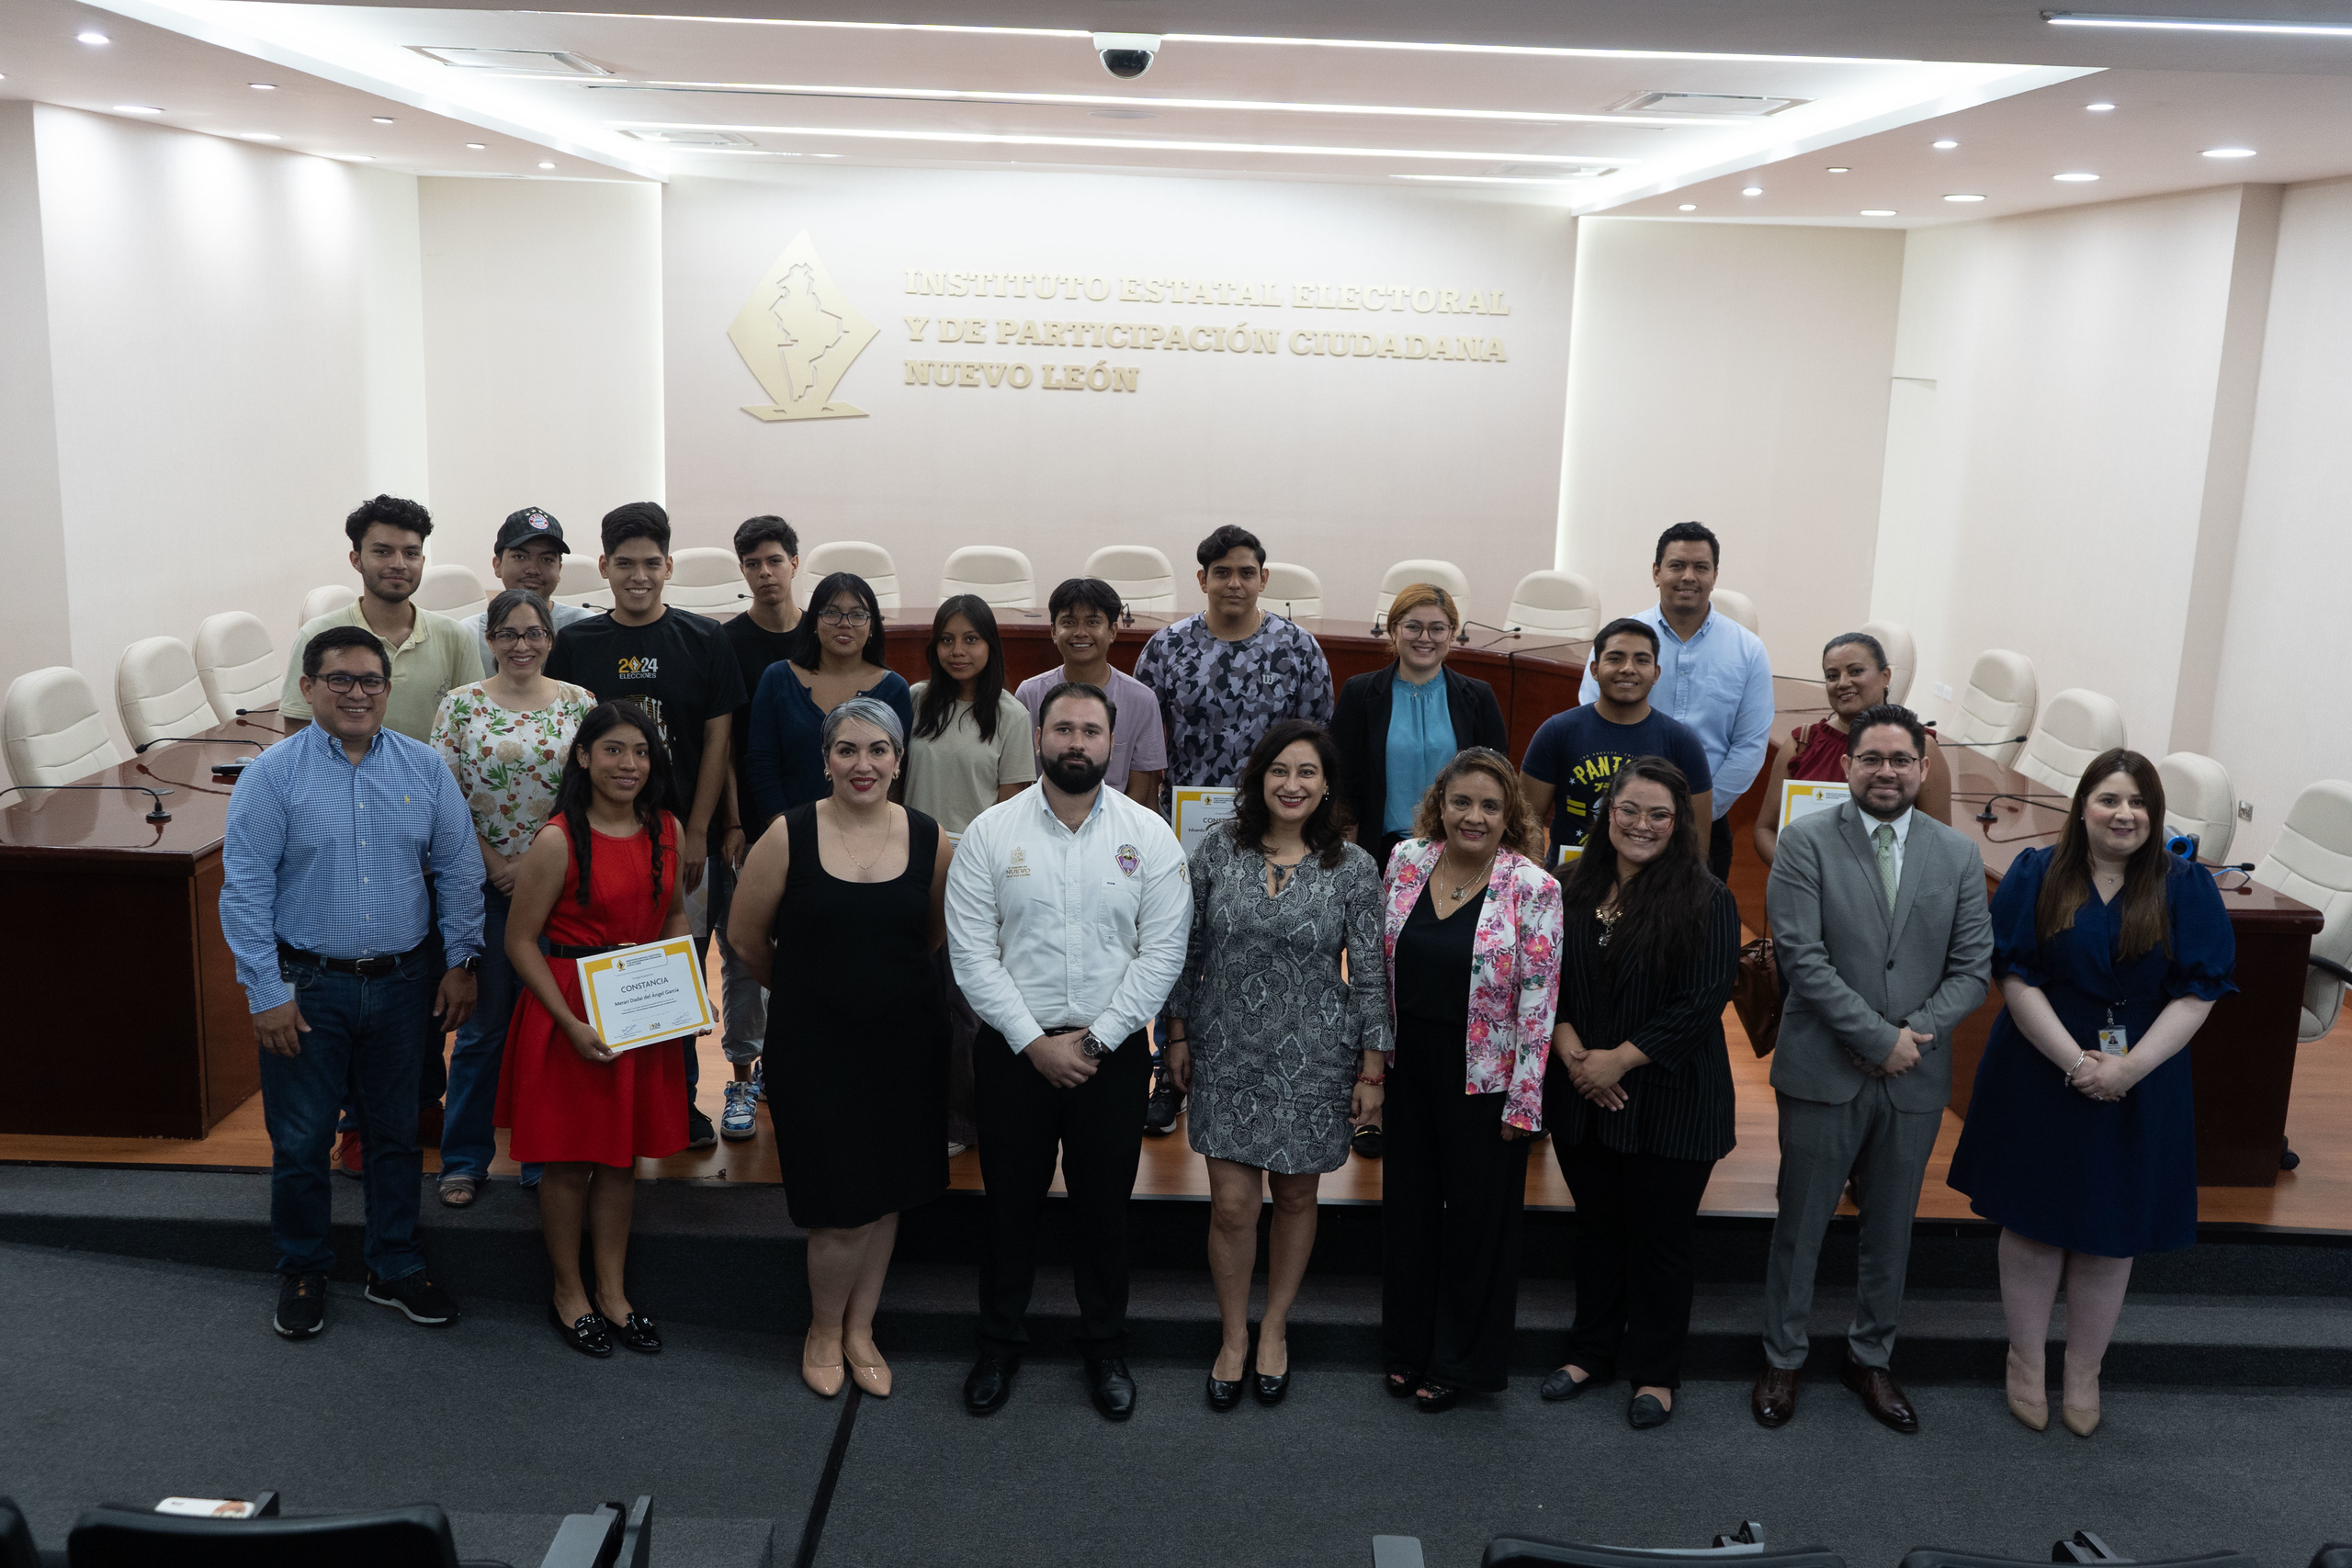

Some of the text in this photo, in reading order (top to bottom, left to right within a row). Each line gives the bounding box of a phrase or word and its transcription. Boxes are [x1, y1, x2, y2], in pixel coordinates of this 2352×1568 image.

[904, 269, 1510, 316] INSTITUTO ESTATAL ELECTORAL
[904, 316, 1508, 363] Y DE PARTICIPACIÓN CIUDADANA
[904, 359, 1139, 392] NUEVO LEÓN
[1573, 755, 1631, 784] PANT
[621, 977, 669, 993] CONSTANCIA
